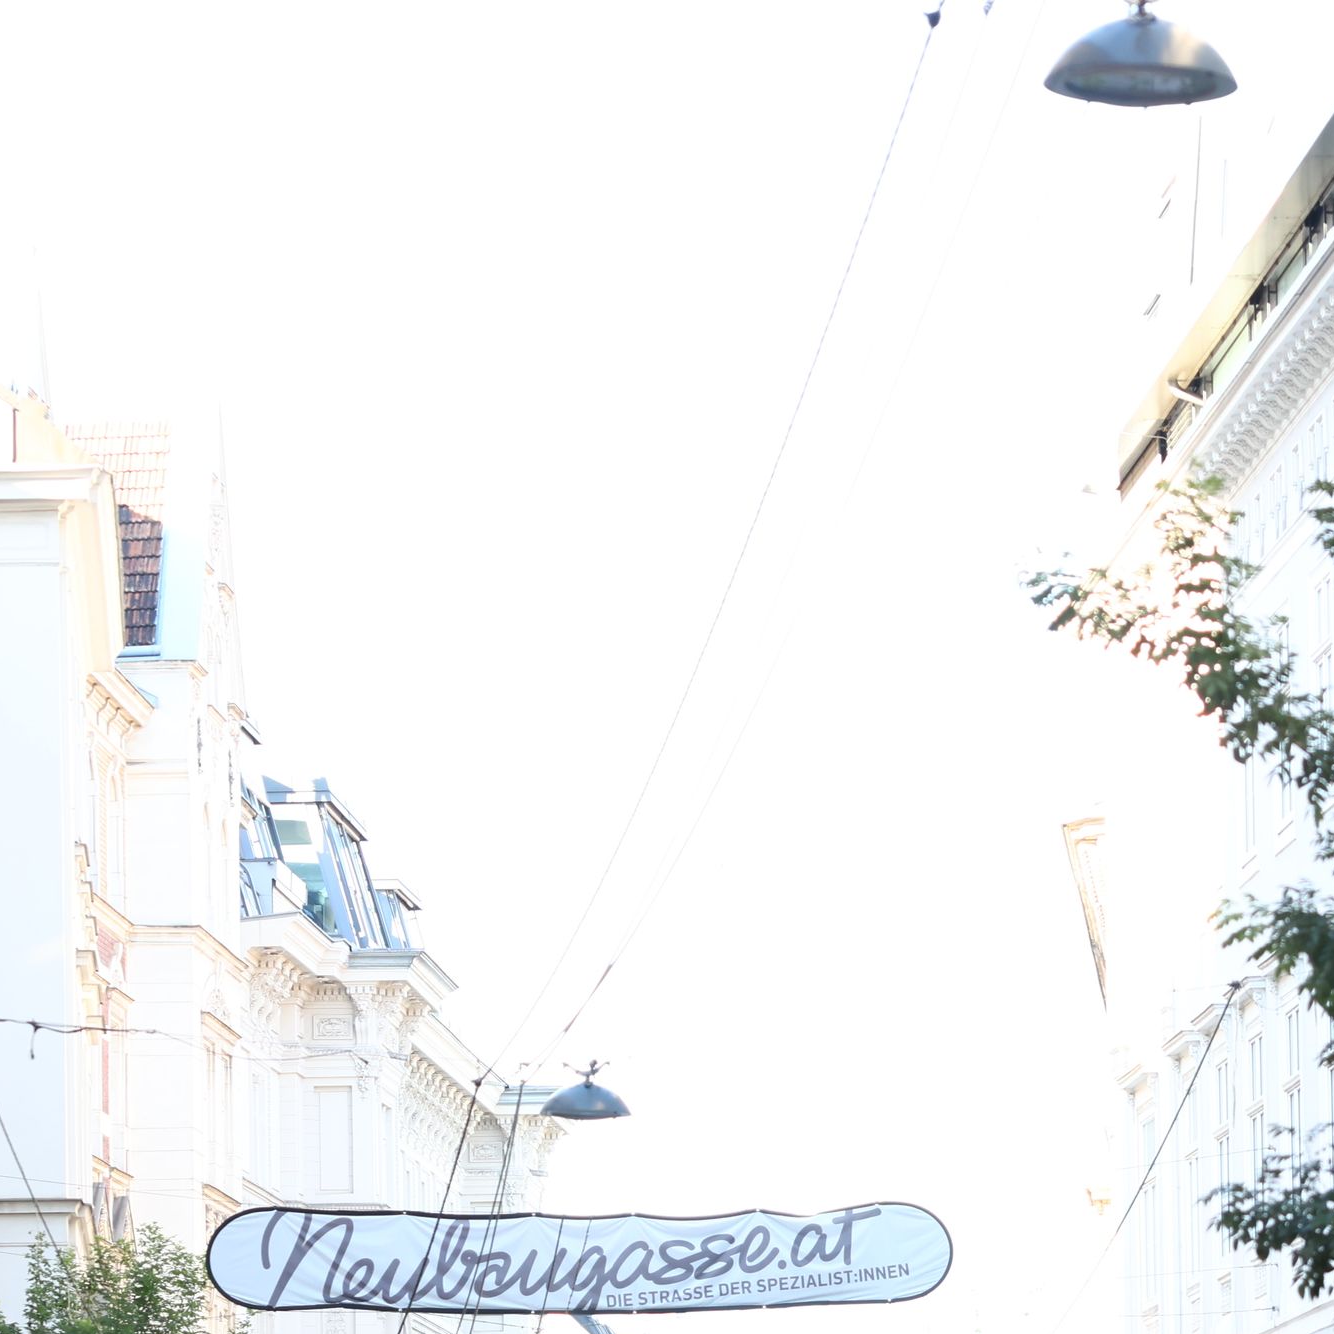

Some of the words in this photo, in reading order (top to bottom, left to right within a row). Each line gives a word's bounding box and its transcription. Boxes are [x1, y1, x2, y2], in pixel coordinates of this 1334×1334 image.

[261, 1207, 882, 1313] Neubaugasse.at
[606, 1293, 634, 1308] DIE
[638, 1284, 714, 1305] STRASSE
[718, 1279, 752, 1297] DER
[757, 1262, 911, 1293] SPEZIALIST:INNEN
